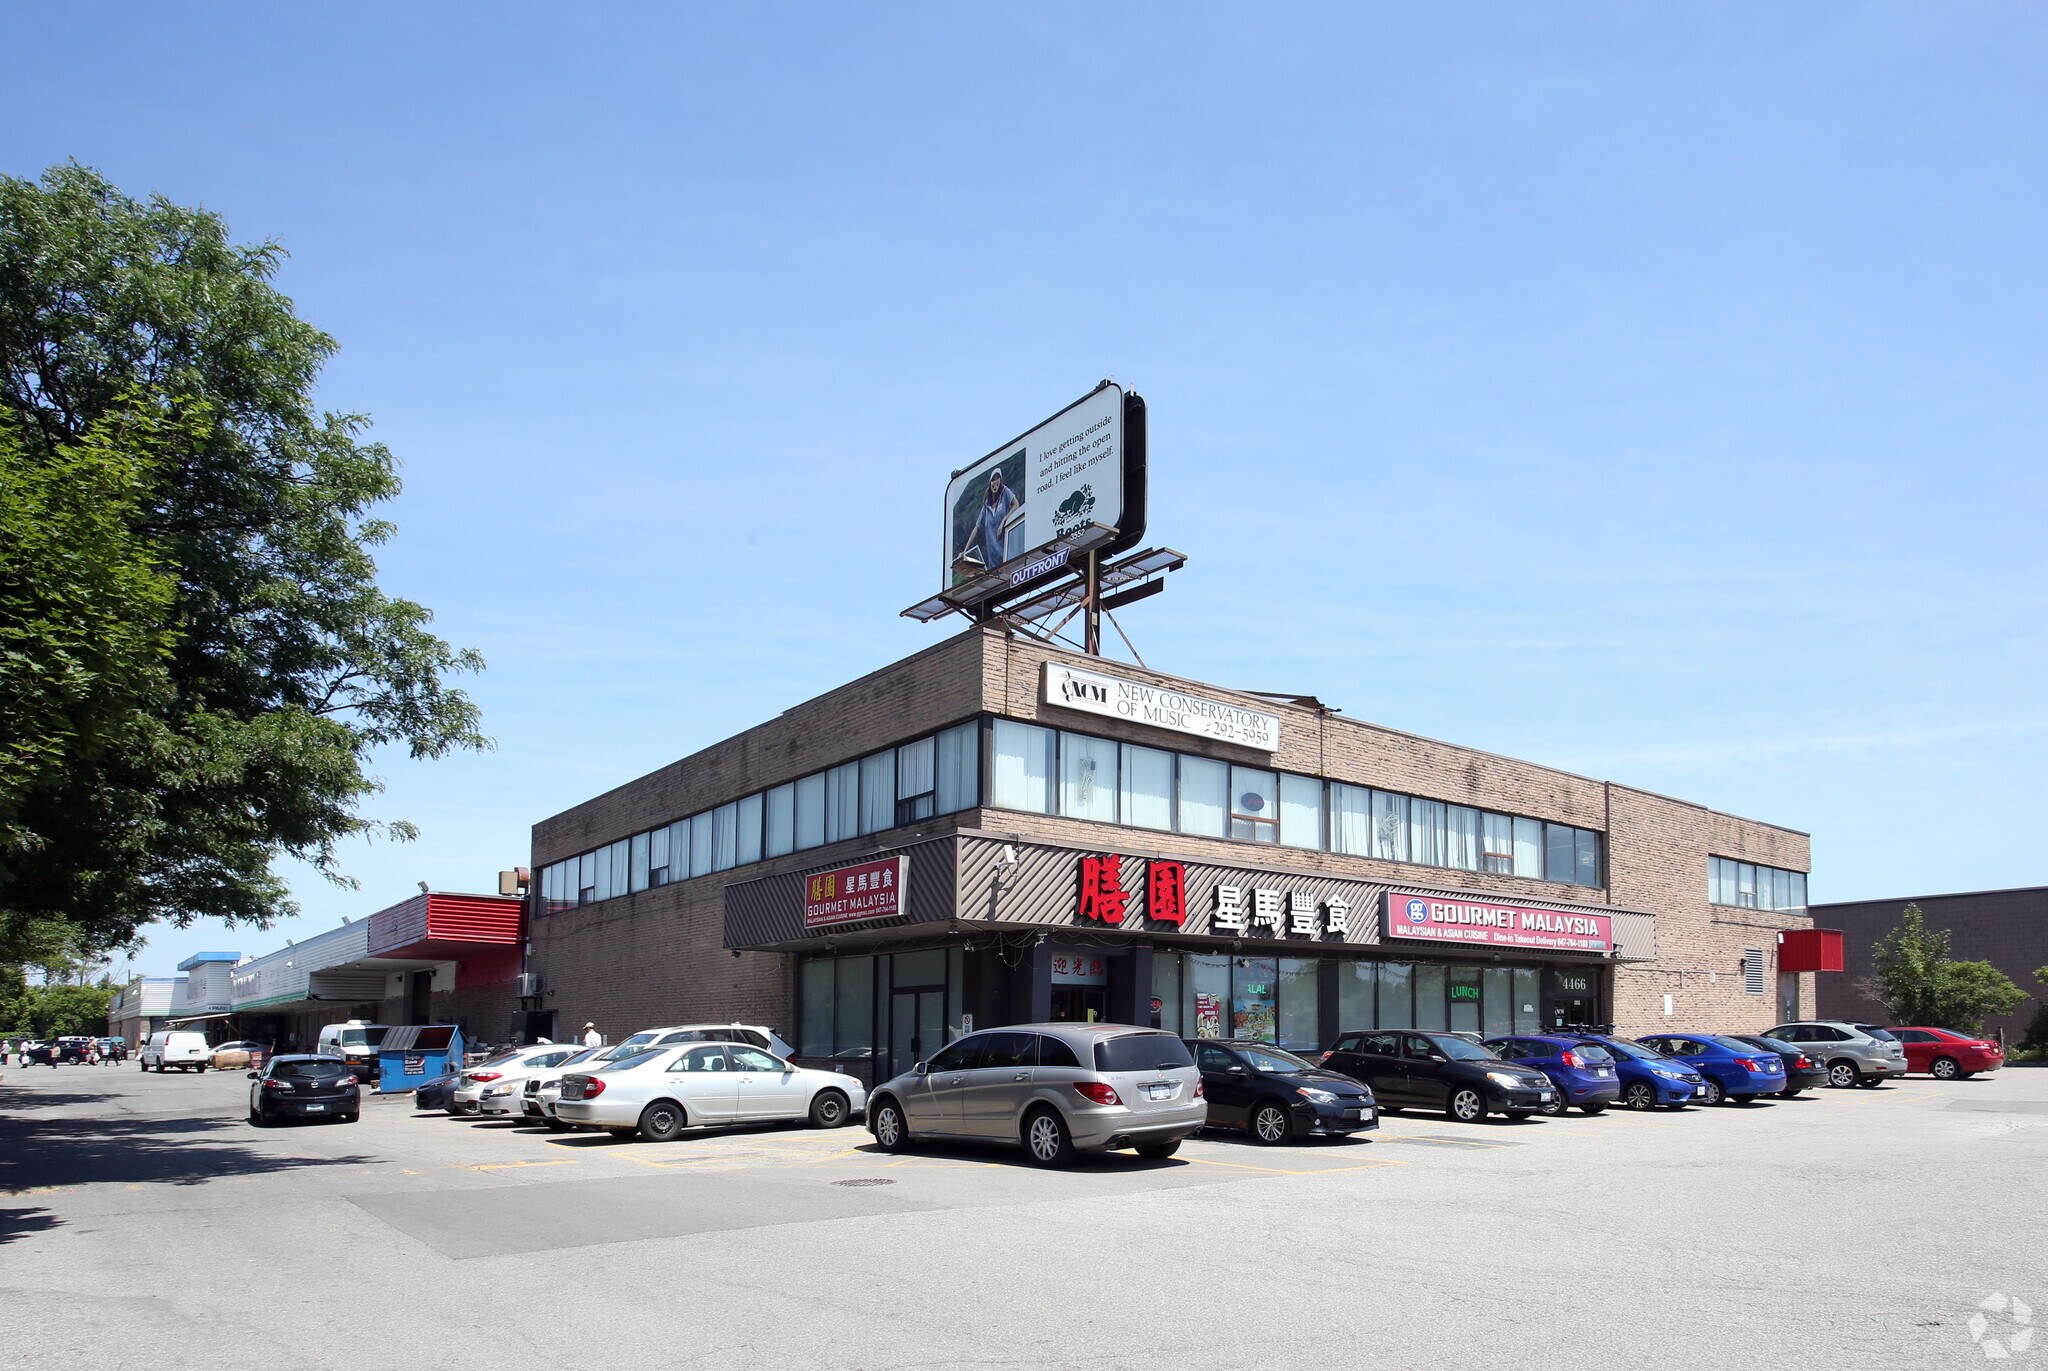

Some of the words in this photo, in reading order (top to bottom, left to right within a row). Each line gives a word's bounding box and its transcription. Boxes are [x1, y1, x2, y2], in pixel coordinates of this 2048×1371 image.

[1044, 446, 1058, 460] love
[1058, 432, 1084, 454] getting
[1084, 416, 1112, 436] outside
[1040, 463, 1052, 478] and
[1054, 451, 1078, 470] hitting
[1078, 444, 1090, 456] the
[1092, 433, 1111, 448] open
[1060, 468, 1072, 482] feel
[1074, 462, 1086, 474] like
[1088, 446, 1114, 467] myself.
[1070, 528, 1086, 540] 3552
[1012, 550, 1068, 584] OUTFRONT
[1117, 700, 1137, 716] OF
[1144, 705, 1190, 728] MUSIC
[1118, 682, 1154, 703] NEW
[1160, 693, 1270, 731] CONSERVATORY
[846, 868, 892, 894] 星馬豐食
[808, 900, 848, 916] GOURMET
[850, 892, 896, 910] MALAYSIA
[1214, 884, 1350, 935] 星馬豐食
[1430, 902, 1516, 928] GOURMET
[1521, 912, 1599, 936] MALAYSIA
[1396, 924, 1436, 936] MALAYSIAN
[1437, 928, 1442, 936] &
[1443, 928, 1463, 938] ASIAN
[1464, 930, 1488, 940] CUISINE
[1494, 932, 1514, 942] Dine-in
[1514, 934, 1535, 944] Takeout
[1536, 936, 1557, 947] Delivery
[1451, 986, 1479, 998] LUNCH
[1562, 978, 1586, 990] 4466
